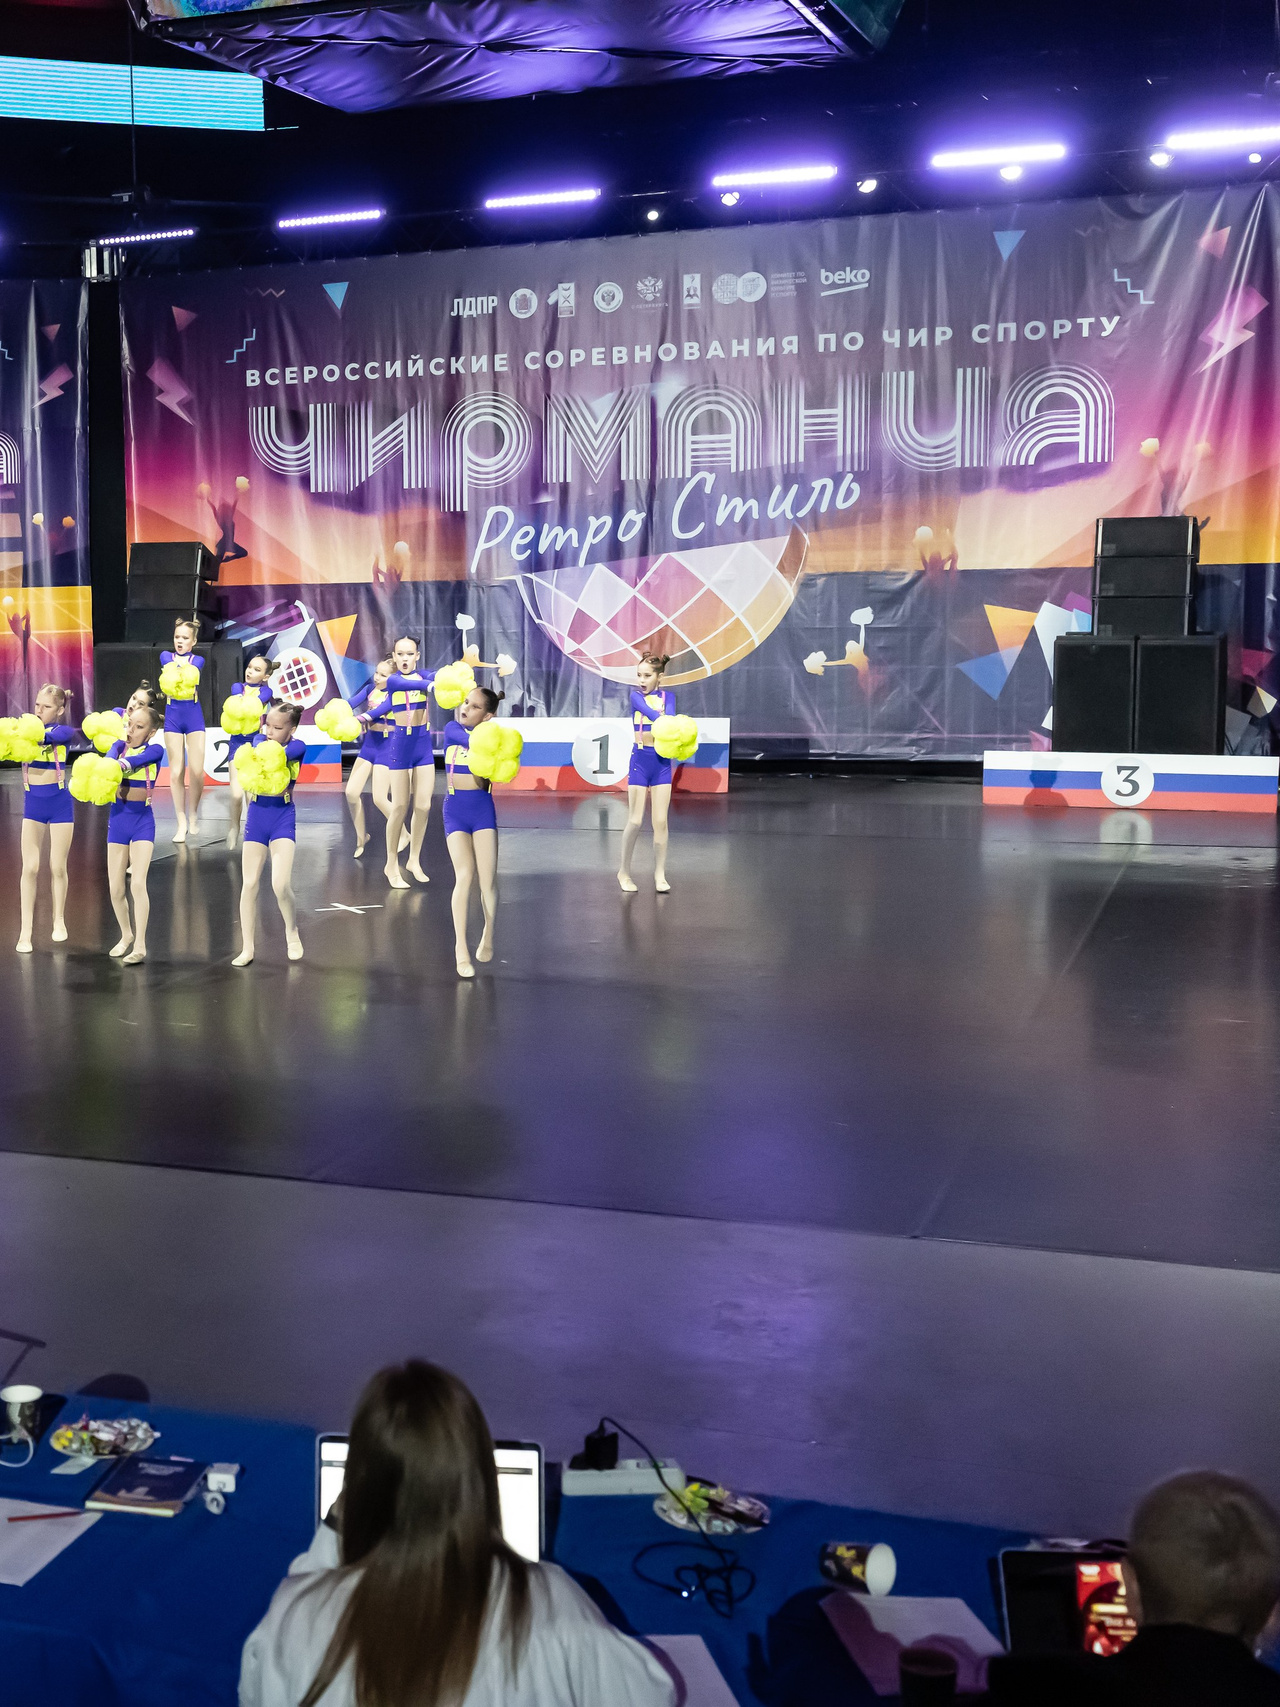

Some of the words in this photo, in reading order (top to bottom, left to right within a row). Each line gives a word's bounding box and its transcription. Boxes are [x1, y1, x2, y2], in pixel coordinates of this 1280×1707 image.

[820, 267, 870, 285] beko
[451, 296, 498, 318] ЛДПР
[246, 352, 510, 388] ВСЕРОССИЙСКИЕ
[524, 336, 799, 370] СОРЕВНОВАНИЯ
[818, 330, 864, 353] ПО
[883, 326, 954, 348] ЧИР
[972, 315, 1122, 344] СПОРТУ
[470, 504, 646, 574] Ретро
[671, 470, 861, 539] Стиль
[213, 739, 230, 773] 2
[592, 733, 617, 775] 1
[1115, 765, 1141, 797] 3
